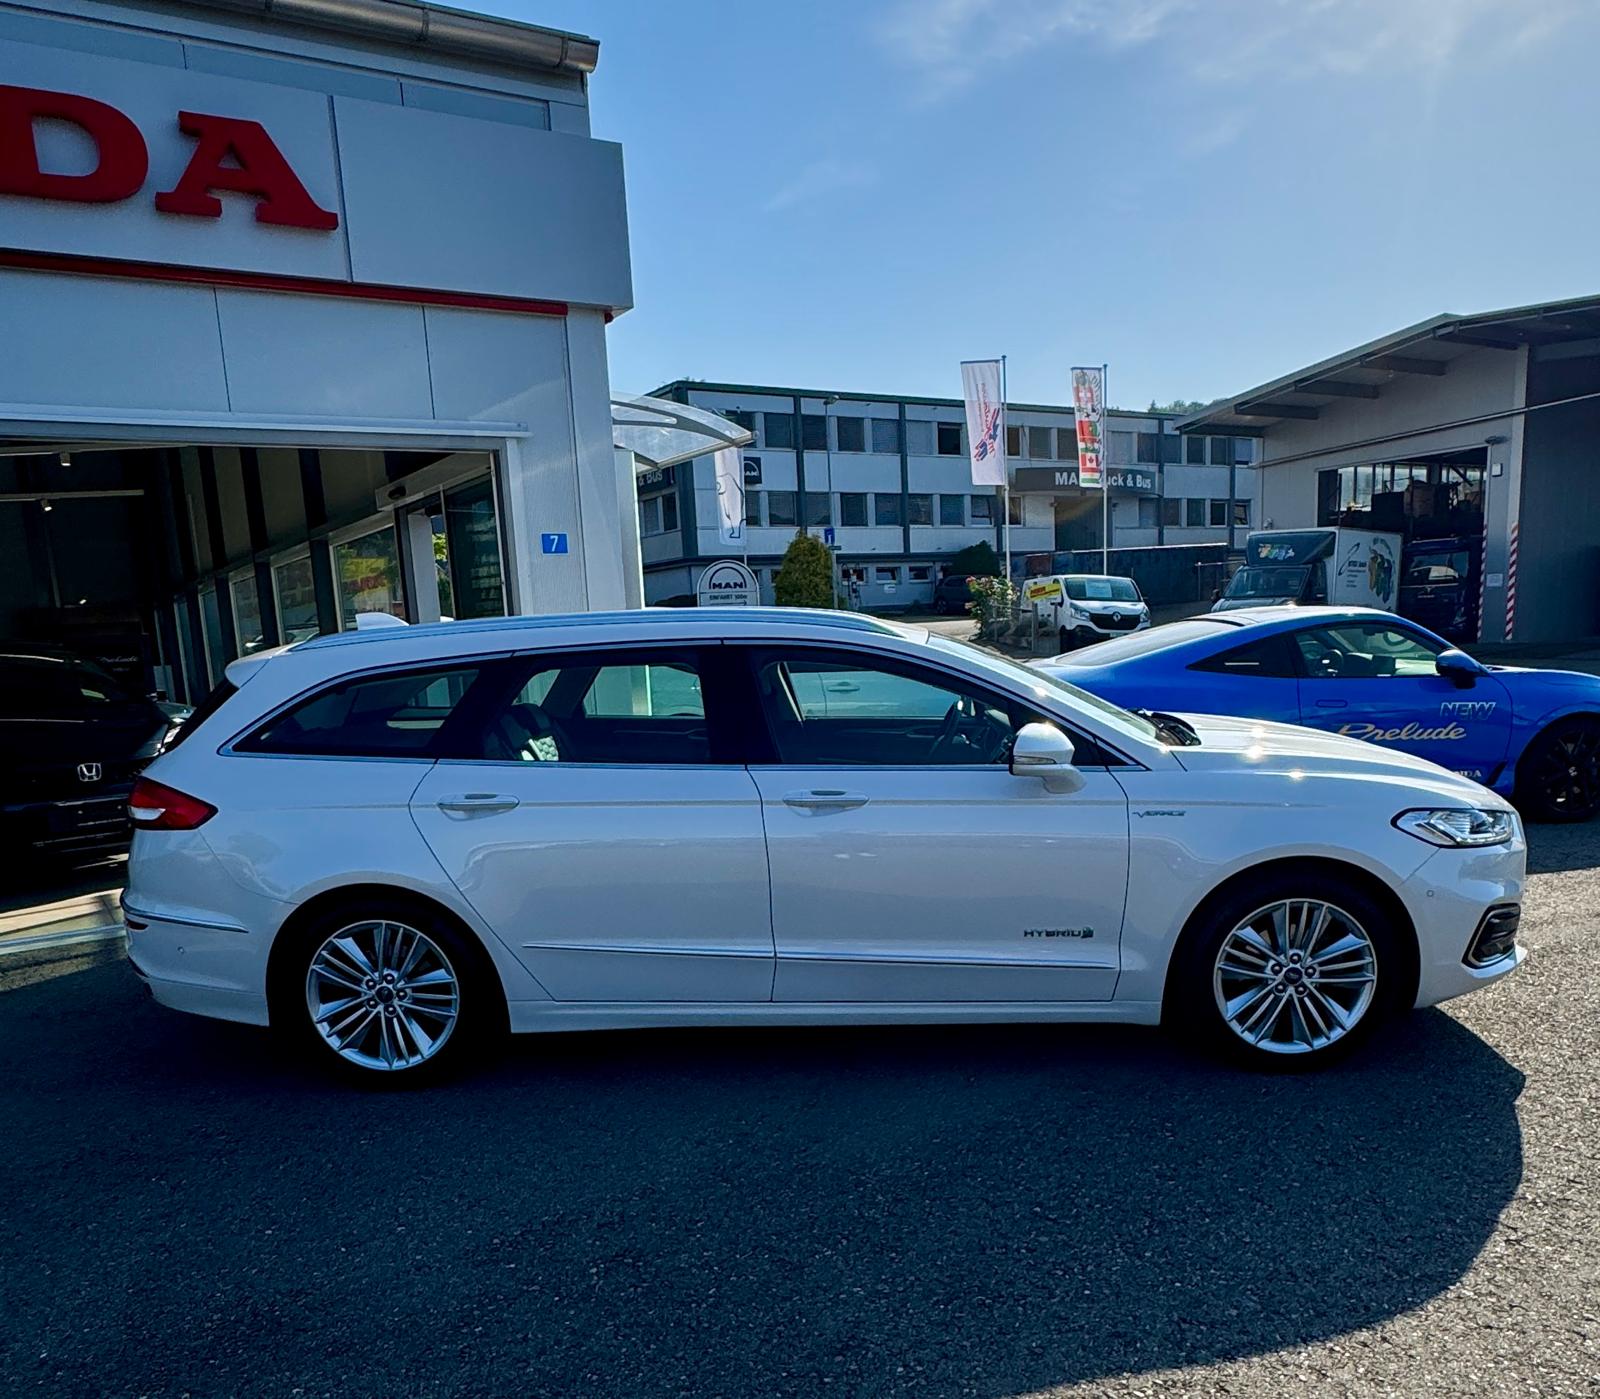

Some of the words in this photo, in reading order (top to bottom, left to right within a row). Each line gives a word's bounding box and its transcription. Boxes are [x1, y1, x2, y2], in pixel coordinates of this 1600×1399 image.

[1055, 471, 1080, 486] MA
[1126, 474, 1134, 487] &
[1136, 474, 1152, 489] Bus
[550, 535, 558, 552] 7
[712, 581, 744, 590] MAN
[1440, 702, 1496, 721] NEW
[1337, 722, 1467, 741] Prelude
[1024, 928, 1082, 938] HYBRID
